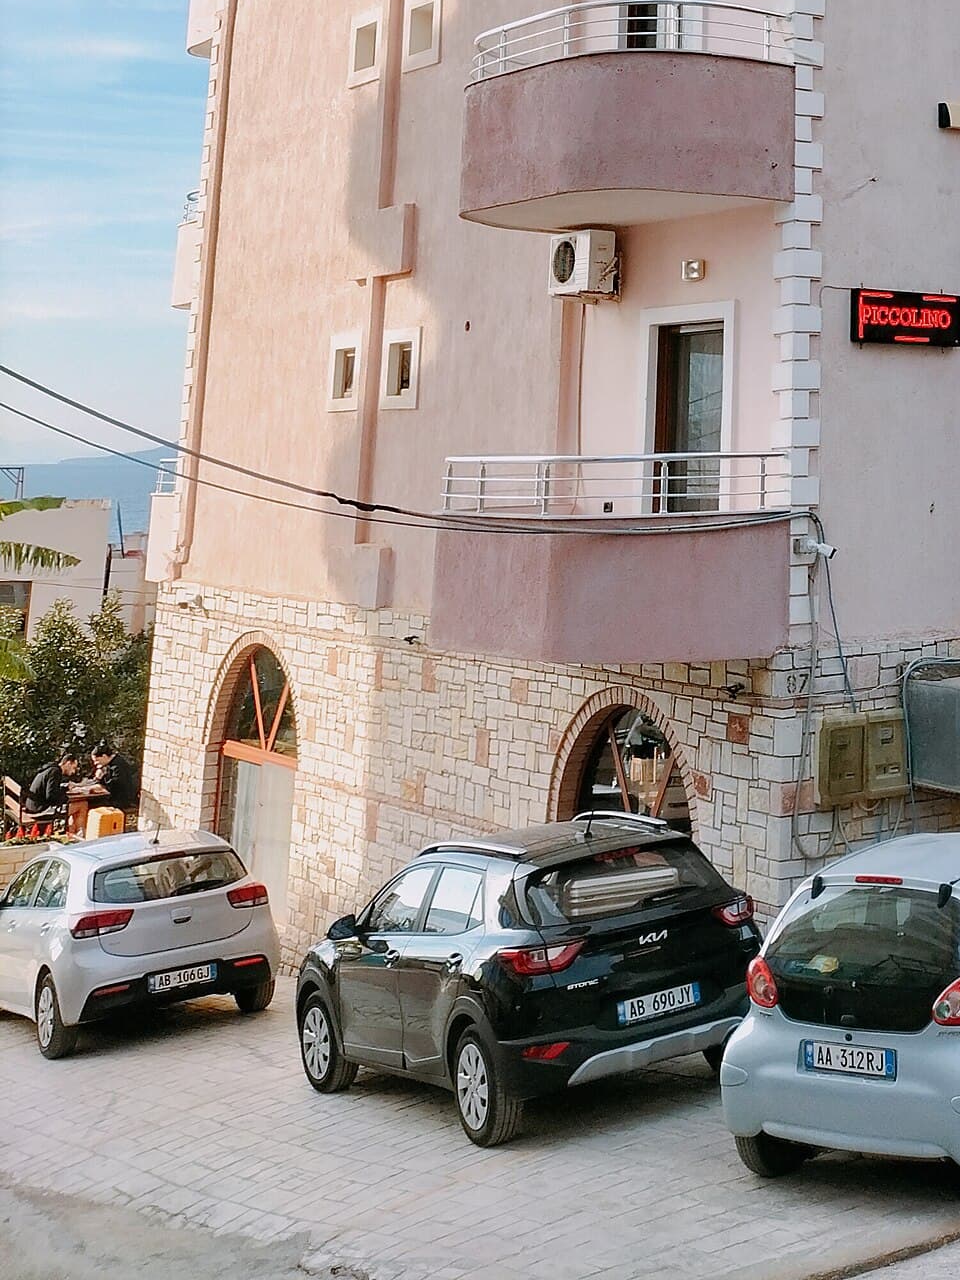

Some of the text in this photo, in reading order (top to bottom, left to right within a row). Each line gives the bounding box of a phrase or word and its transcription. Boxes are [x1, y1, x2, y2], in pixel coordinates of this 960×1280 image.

[862, 305, 951, 329] PICCOLINO
[639, 929, 668, 945] KIA
[159, 974, 171, 987] AB
[567, 978, 599, 990] STONIC
[630, 999, 646, 1018] AB
[817, 1046, 833, 1066] AA
